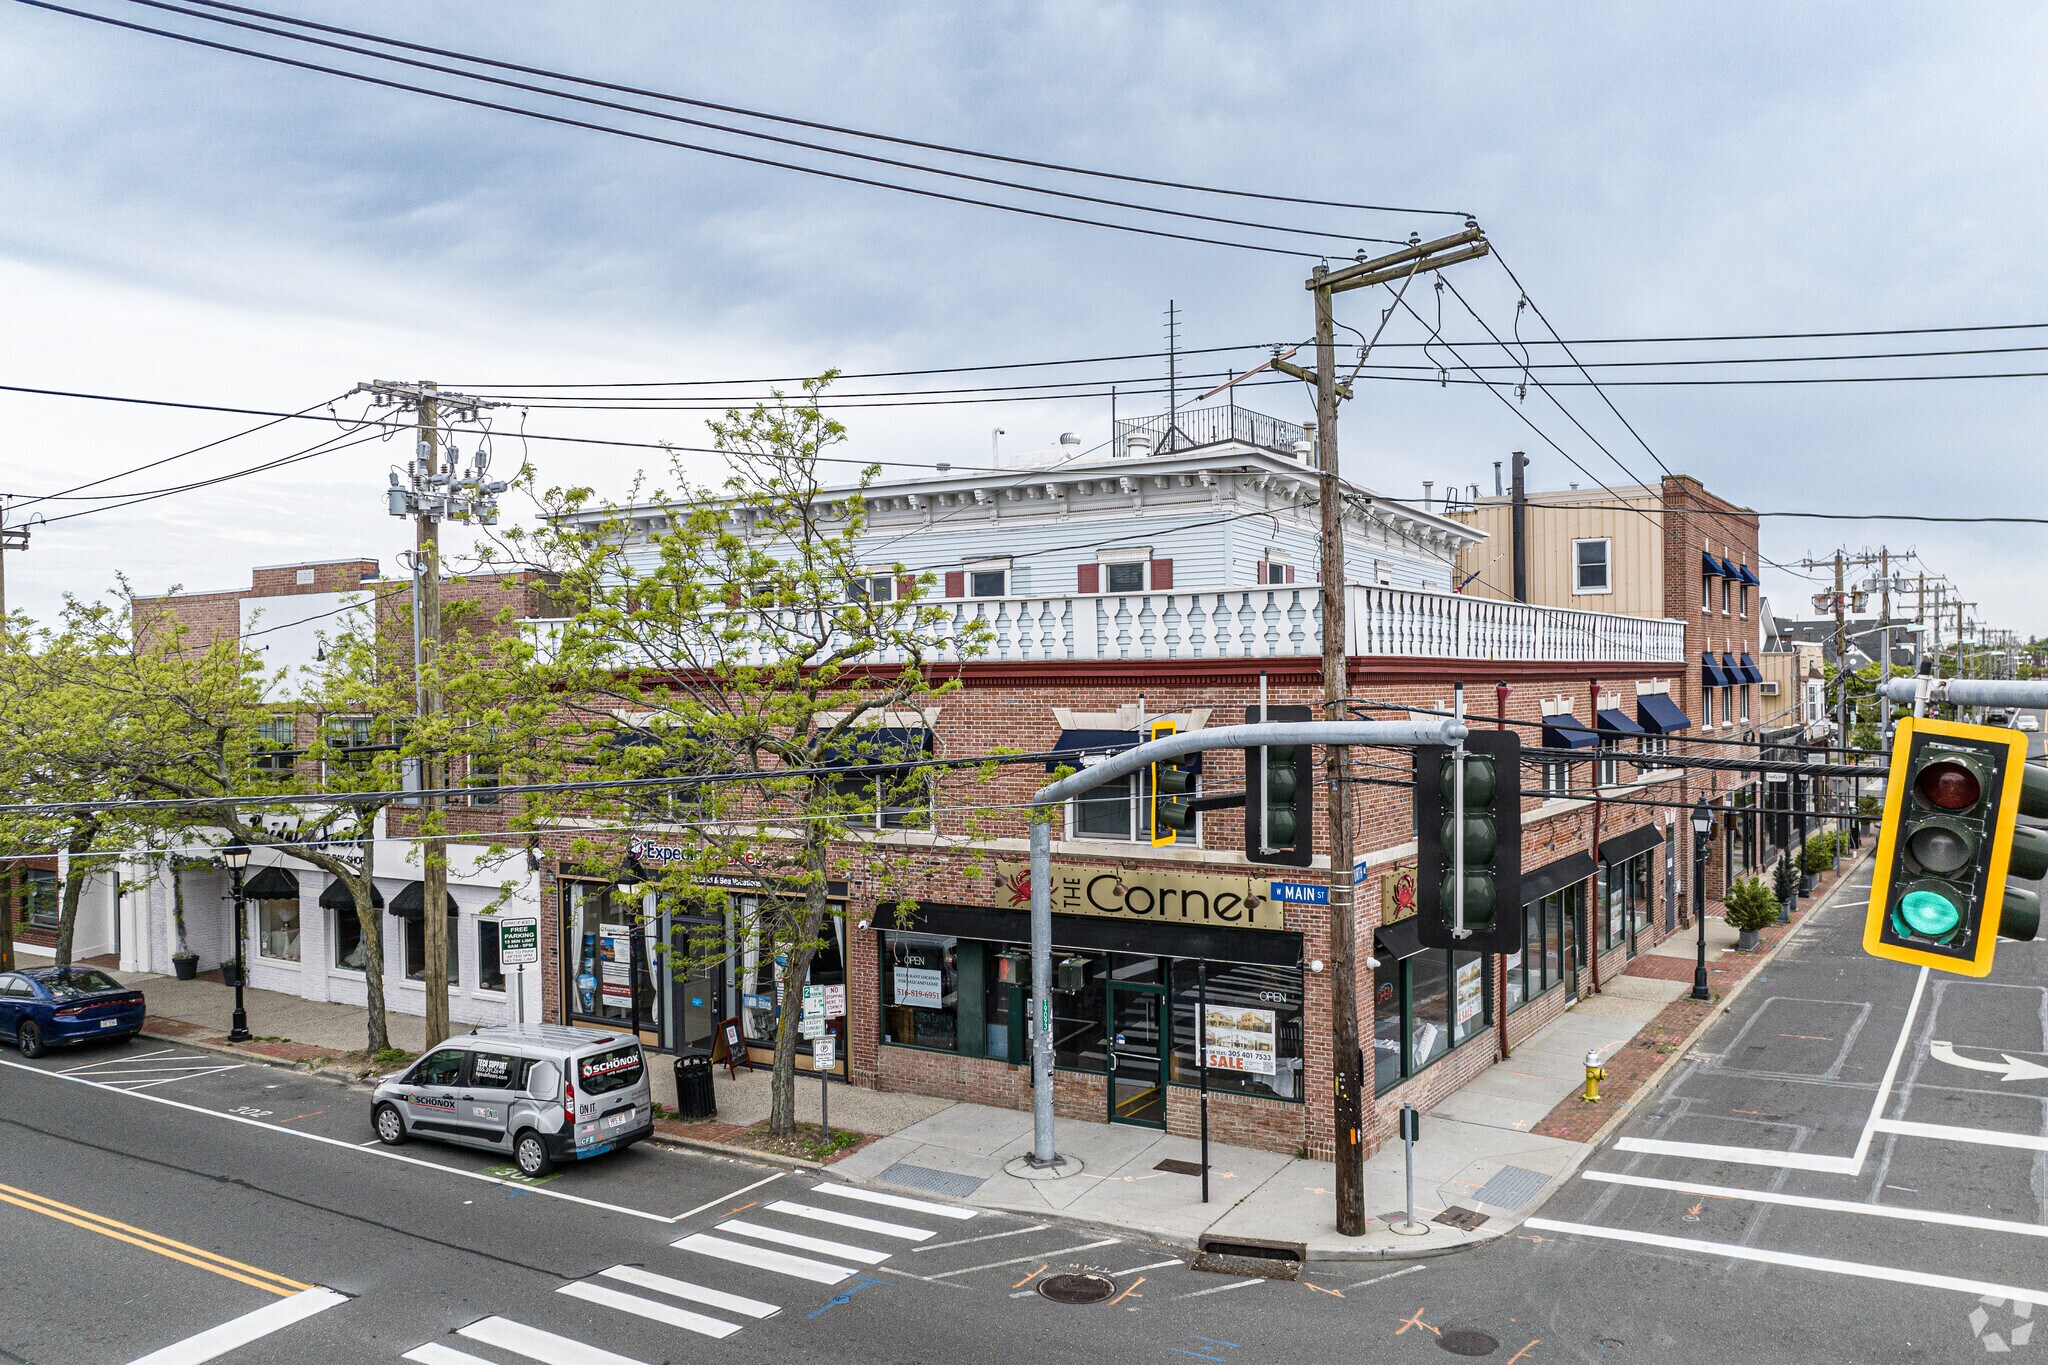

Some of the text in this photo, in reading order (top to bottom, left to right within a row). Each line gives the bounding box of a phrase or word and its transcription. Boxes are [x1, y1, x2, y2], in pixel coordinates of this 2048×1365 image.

[719, 877, 732, 885] Sea
[1063, 874, 1267, 923] THE Corner
[1276, 886, 1325, 901] W MAIN ST
[904, 956, 925, 965] OPEN
[804, 988, 810, 998] 2
[897, 988, 939, 999] 516-819-6951
[1259, 991, 1287, 1003] OPEN
[1376, 986, 1393, 1004] OPEN
[1227, 1050, 1241, 1058] 305
[477, 1059, 508, 1070] TECH SUPPORT
[592, 1053, 639, 1073] SCHÖNOX
[1210, 1055, 1244, 1070] SALE
[416, 1096, 456, 1108] SCHÖNOX
[228, 1106, 273, 1117] 302
[579, 1104, 589, 1114] ÖN
